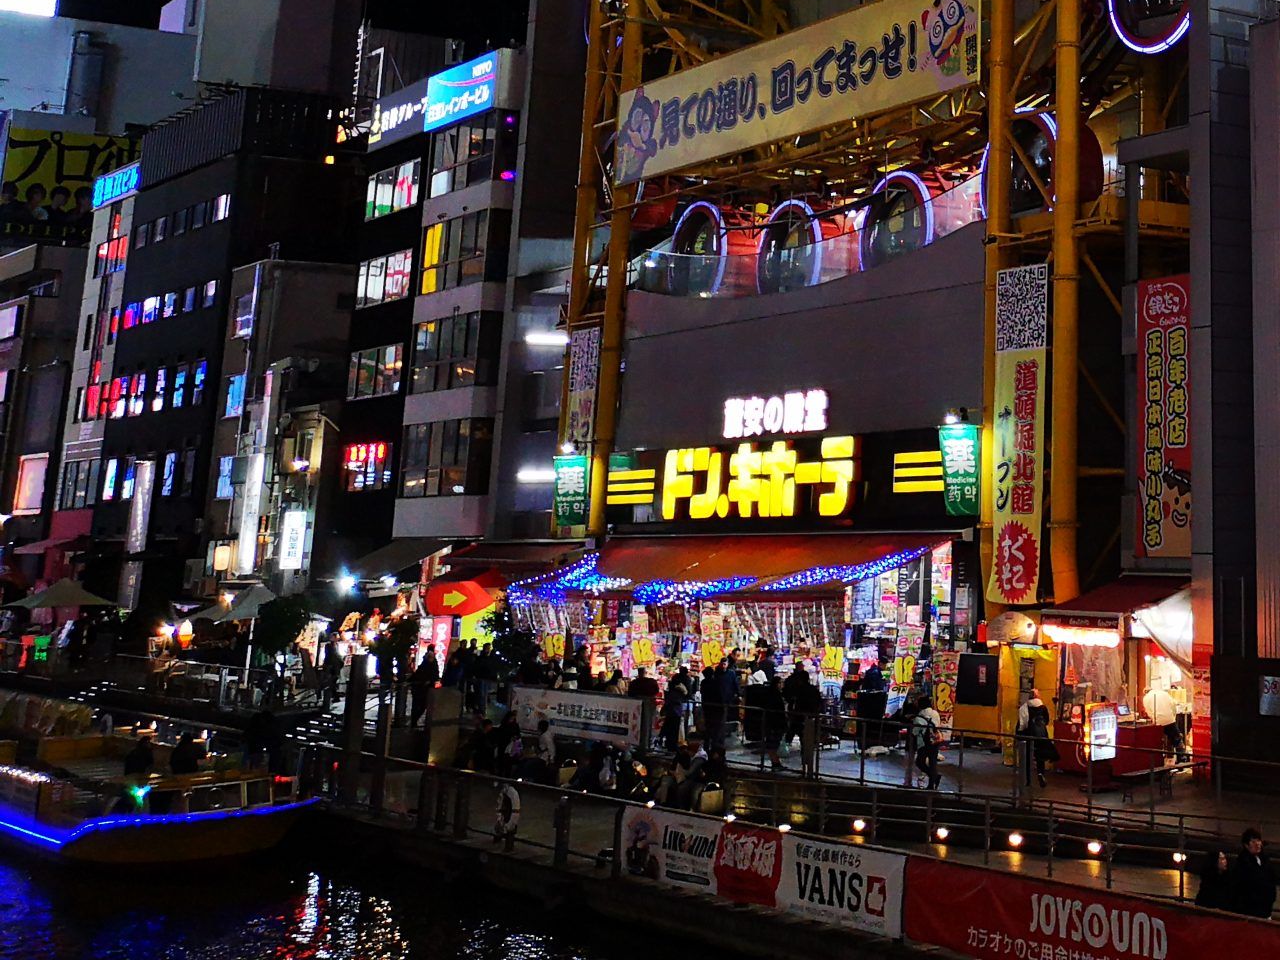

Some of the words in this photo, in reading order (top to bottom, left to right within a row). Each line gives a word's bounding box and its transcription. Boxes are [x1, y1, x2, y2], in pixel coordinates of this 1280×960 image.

[1167, 327, 1188, 448] 百年老店
[944, 438, 977, 476] 薬
[1010, 358, 1039, 515] 道頓堀北館
[557, 465, 586, 495] 薬
[795, 862, 864, 914] VANS
[1029, 892, 1169, 960] JOYSOUND
